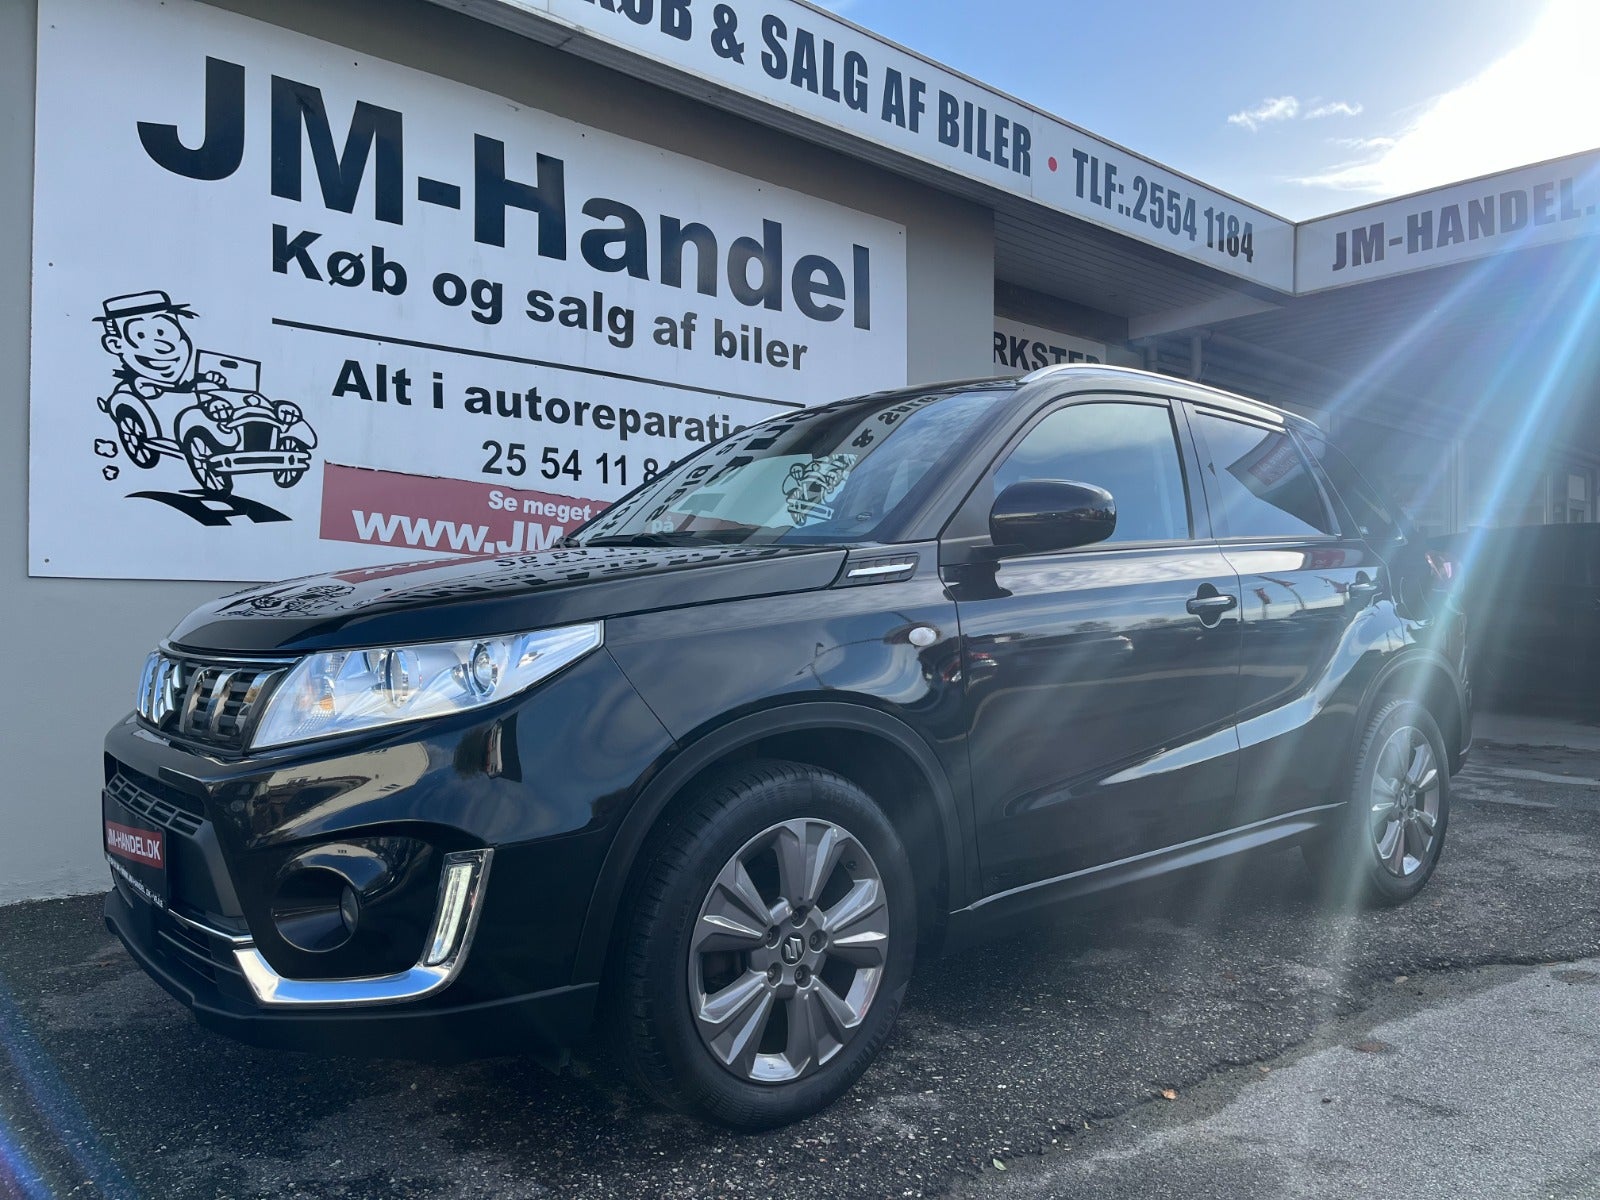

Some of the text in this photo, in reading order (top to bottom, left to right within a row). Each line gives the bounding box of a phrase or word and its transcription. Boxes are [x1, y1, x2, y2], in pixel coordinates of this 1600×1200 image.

[711, 3, 745, 65] &
[761, 14, 868, 114] SALG
[881, 67, 926, 134] AF
[938, 89, 1032, 177] BILER
[1204, 206, 1254, 264] 1184
[136, 55, 871, 331] JM-Handel
[271, 223, 809, 371] Køb og salg af biler
[332, 359, 413, 406] Alt
[433, 371, 443, 409] i
[482, 440, 677, 486] 25 54 11 8
[351, 508, 564, 555] www.JM
[488, 490, 518, 512] Se
[523, 499, 592, 525] meget
[107, 828, 161, 861] JM-HANDEL.DK
